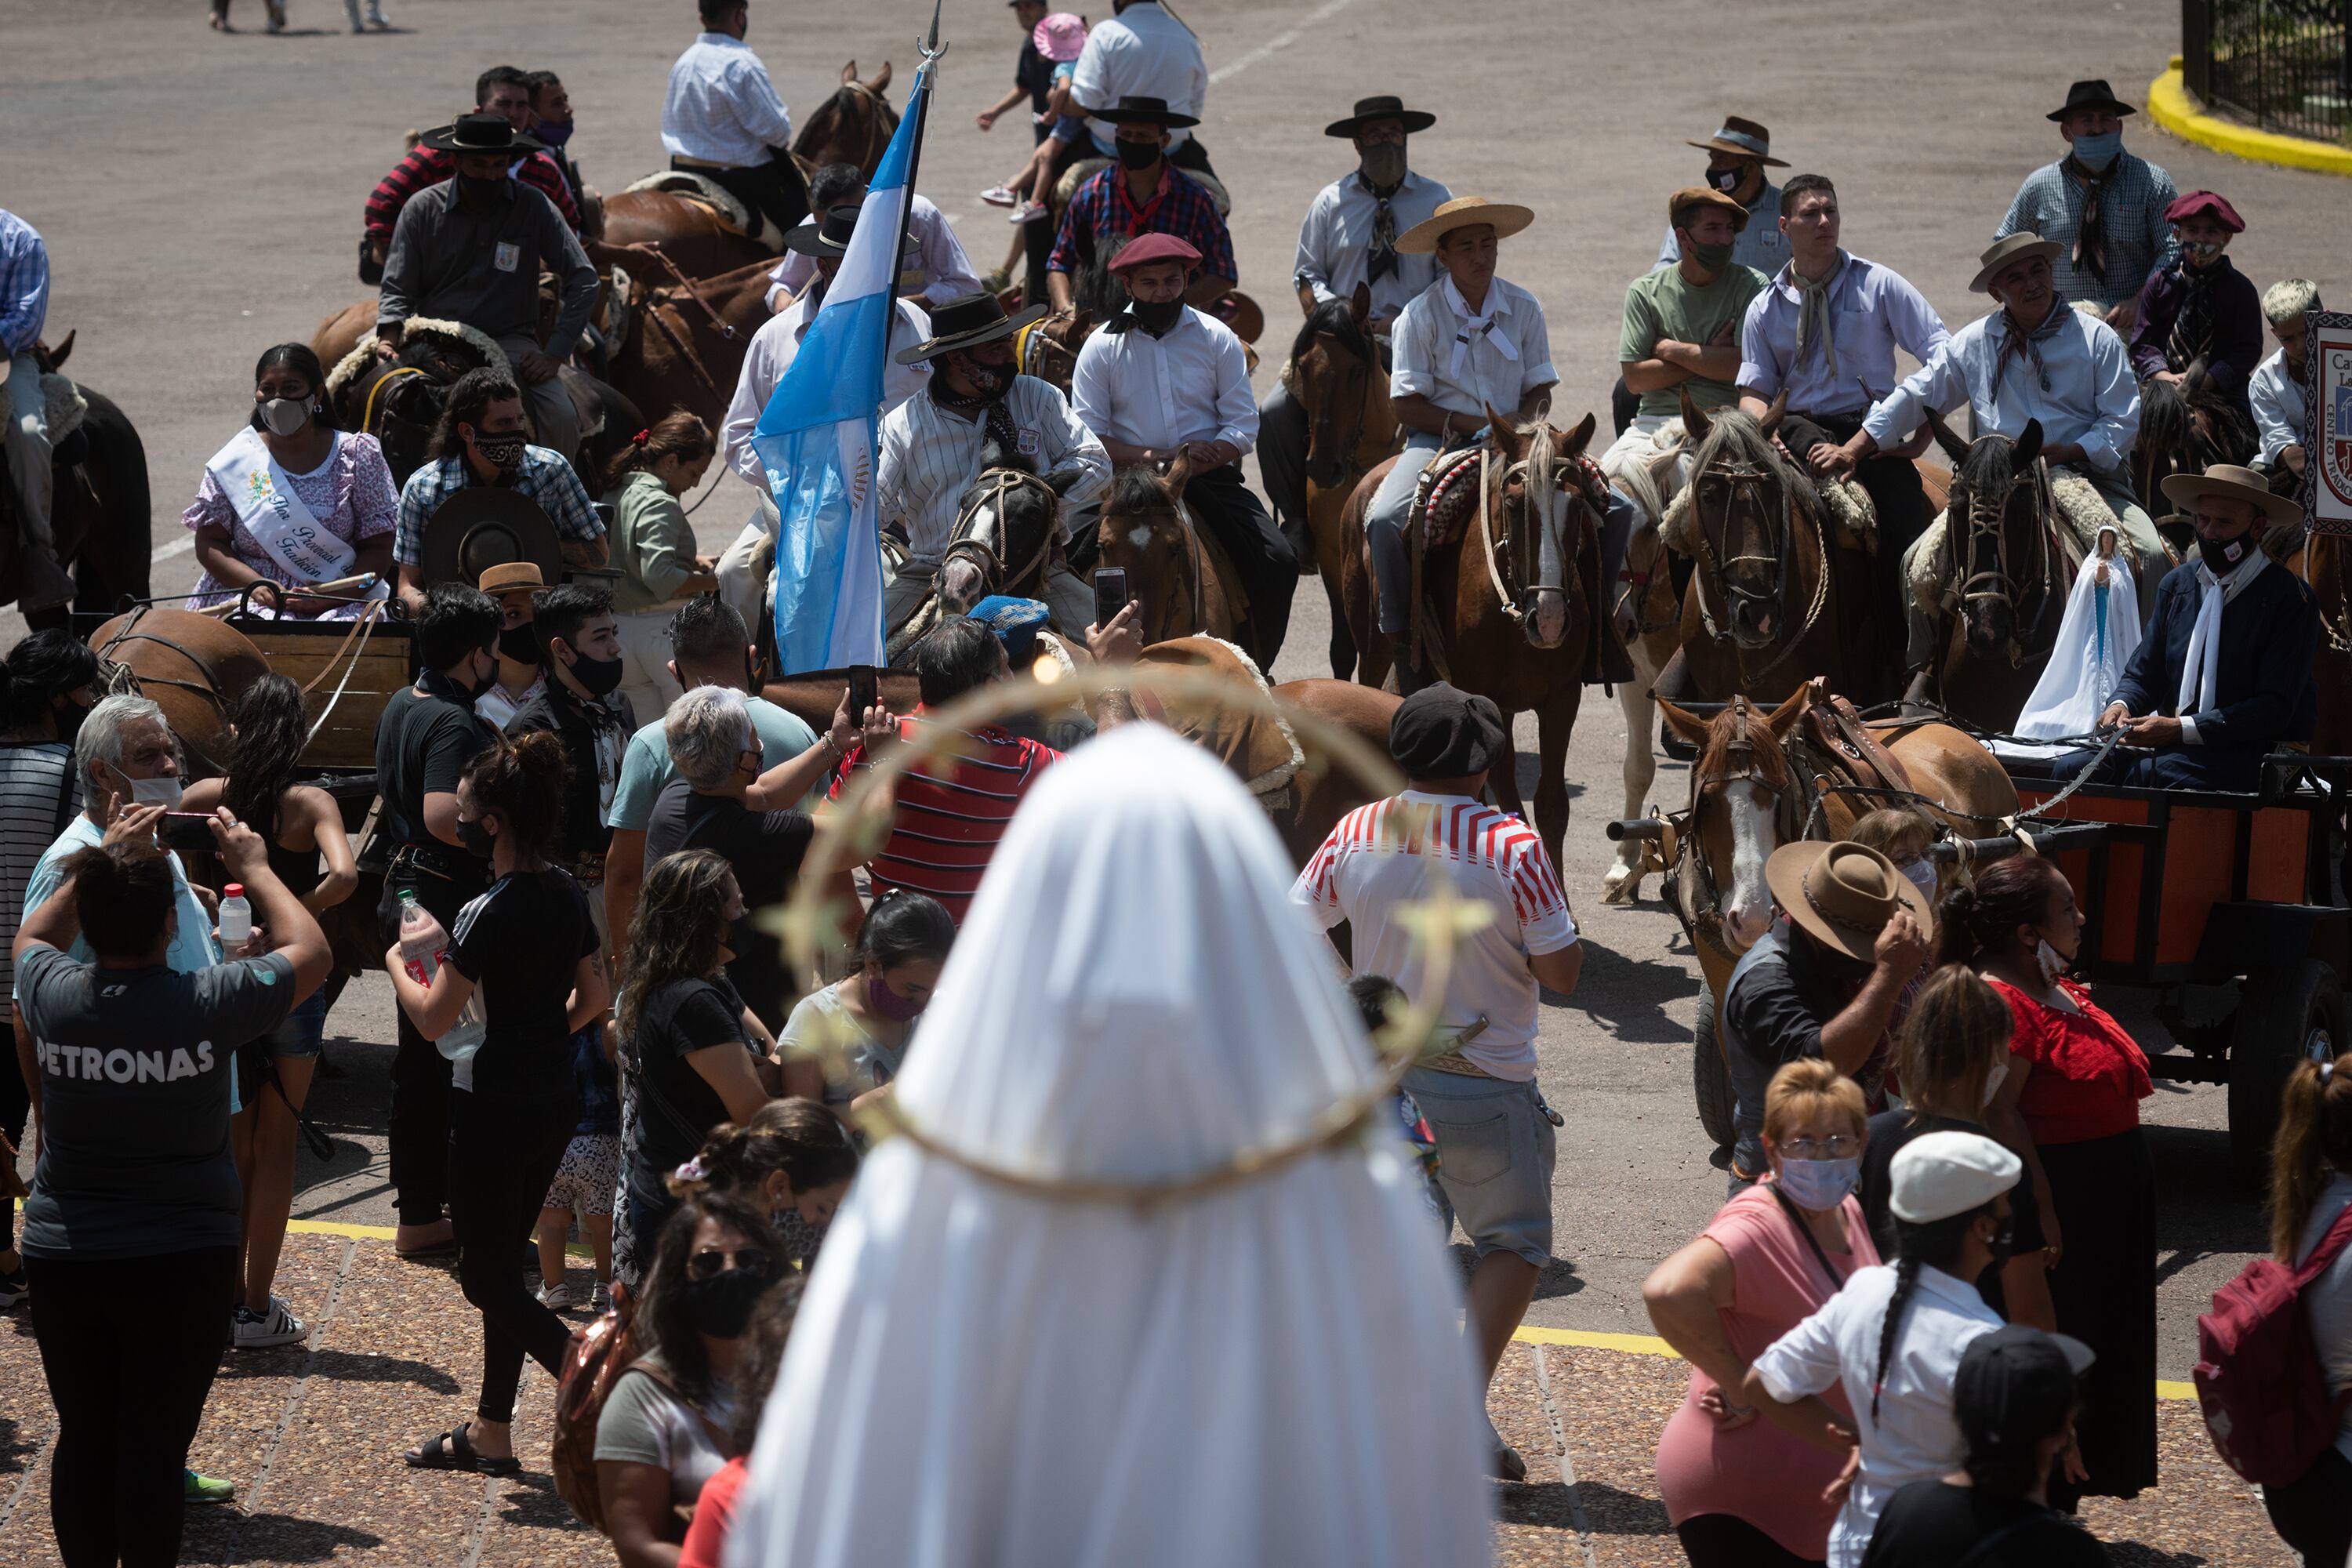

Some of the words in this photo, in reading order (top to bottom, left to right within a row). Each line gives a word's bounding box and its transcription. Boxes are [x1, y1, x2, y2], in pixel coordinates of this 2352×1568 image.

[2332, 354, 2352, 370] Ca
[2326, 404, 2335, 456] CENTRO
[269, 495, 290, 521] Flor
[292, 526, 342, 564] Provincial
[275, 537, 321, 578] Tradición
[36, 1036, 214, 1083] PETRONAS
